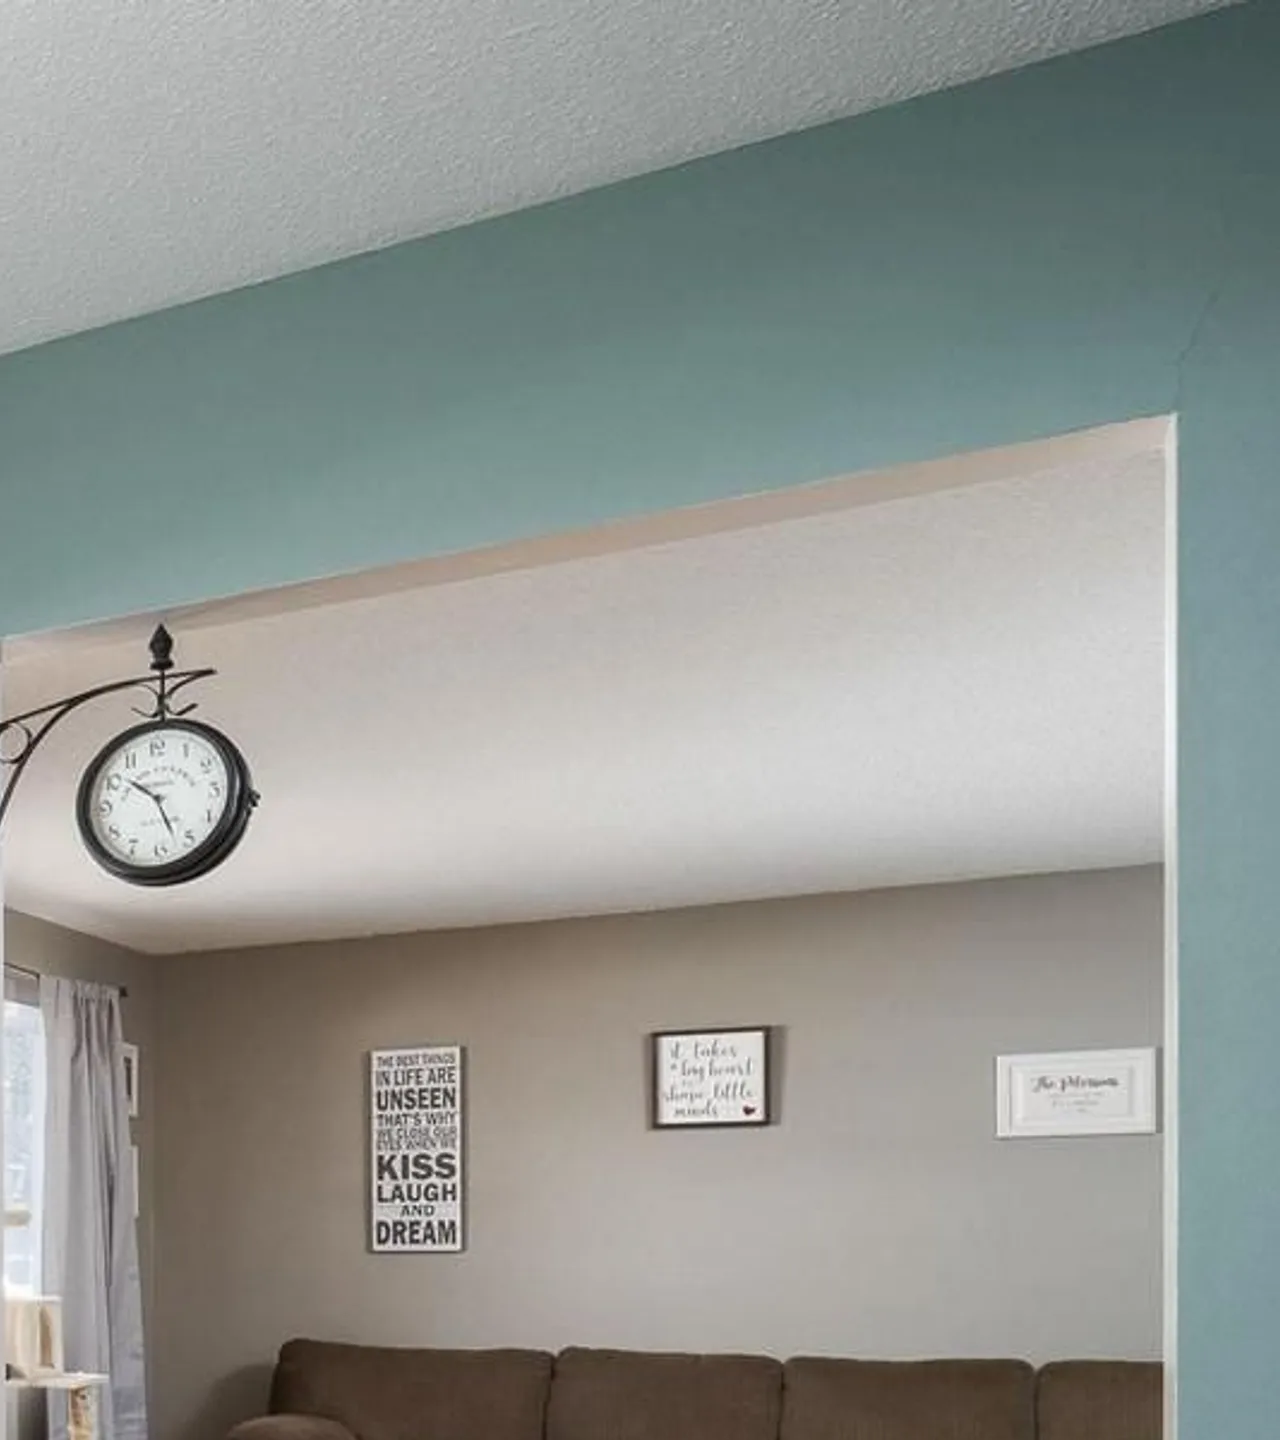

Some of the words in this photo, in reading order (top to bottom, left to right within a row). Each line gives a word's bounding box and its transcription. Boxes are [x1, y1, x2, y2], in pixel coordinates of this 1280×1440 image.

[149, 739, 166, 757] 12
[125, 752, 137, 770] 11
[107, 772, 122, 792] 10
[377, 1070, 391, 1086] IN
[394, 1068, 423, 1086] LIFE
[427, 1066, 456, 1084] ARE
[377, 1088, 456, 1111] UNSEEN
[377, 1111, 422, 1127] THAT'S
[426, 1111, 457, 1125] WHY
[377, 1153, 457, 1181] KISS
[377, 1183, 456, 1203] LAUGH
[400, 1204, 436, 1217] AND
[377, 1219, 456, 1246] DREAM
